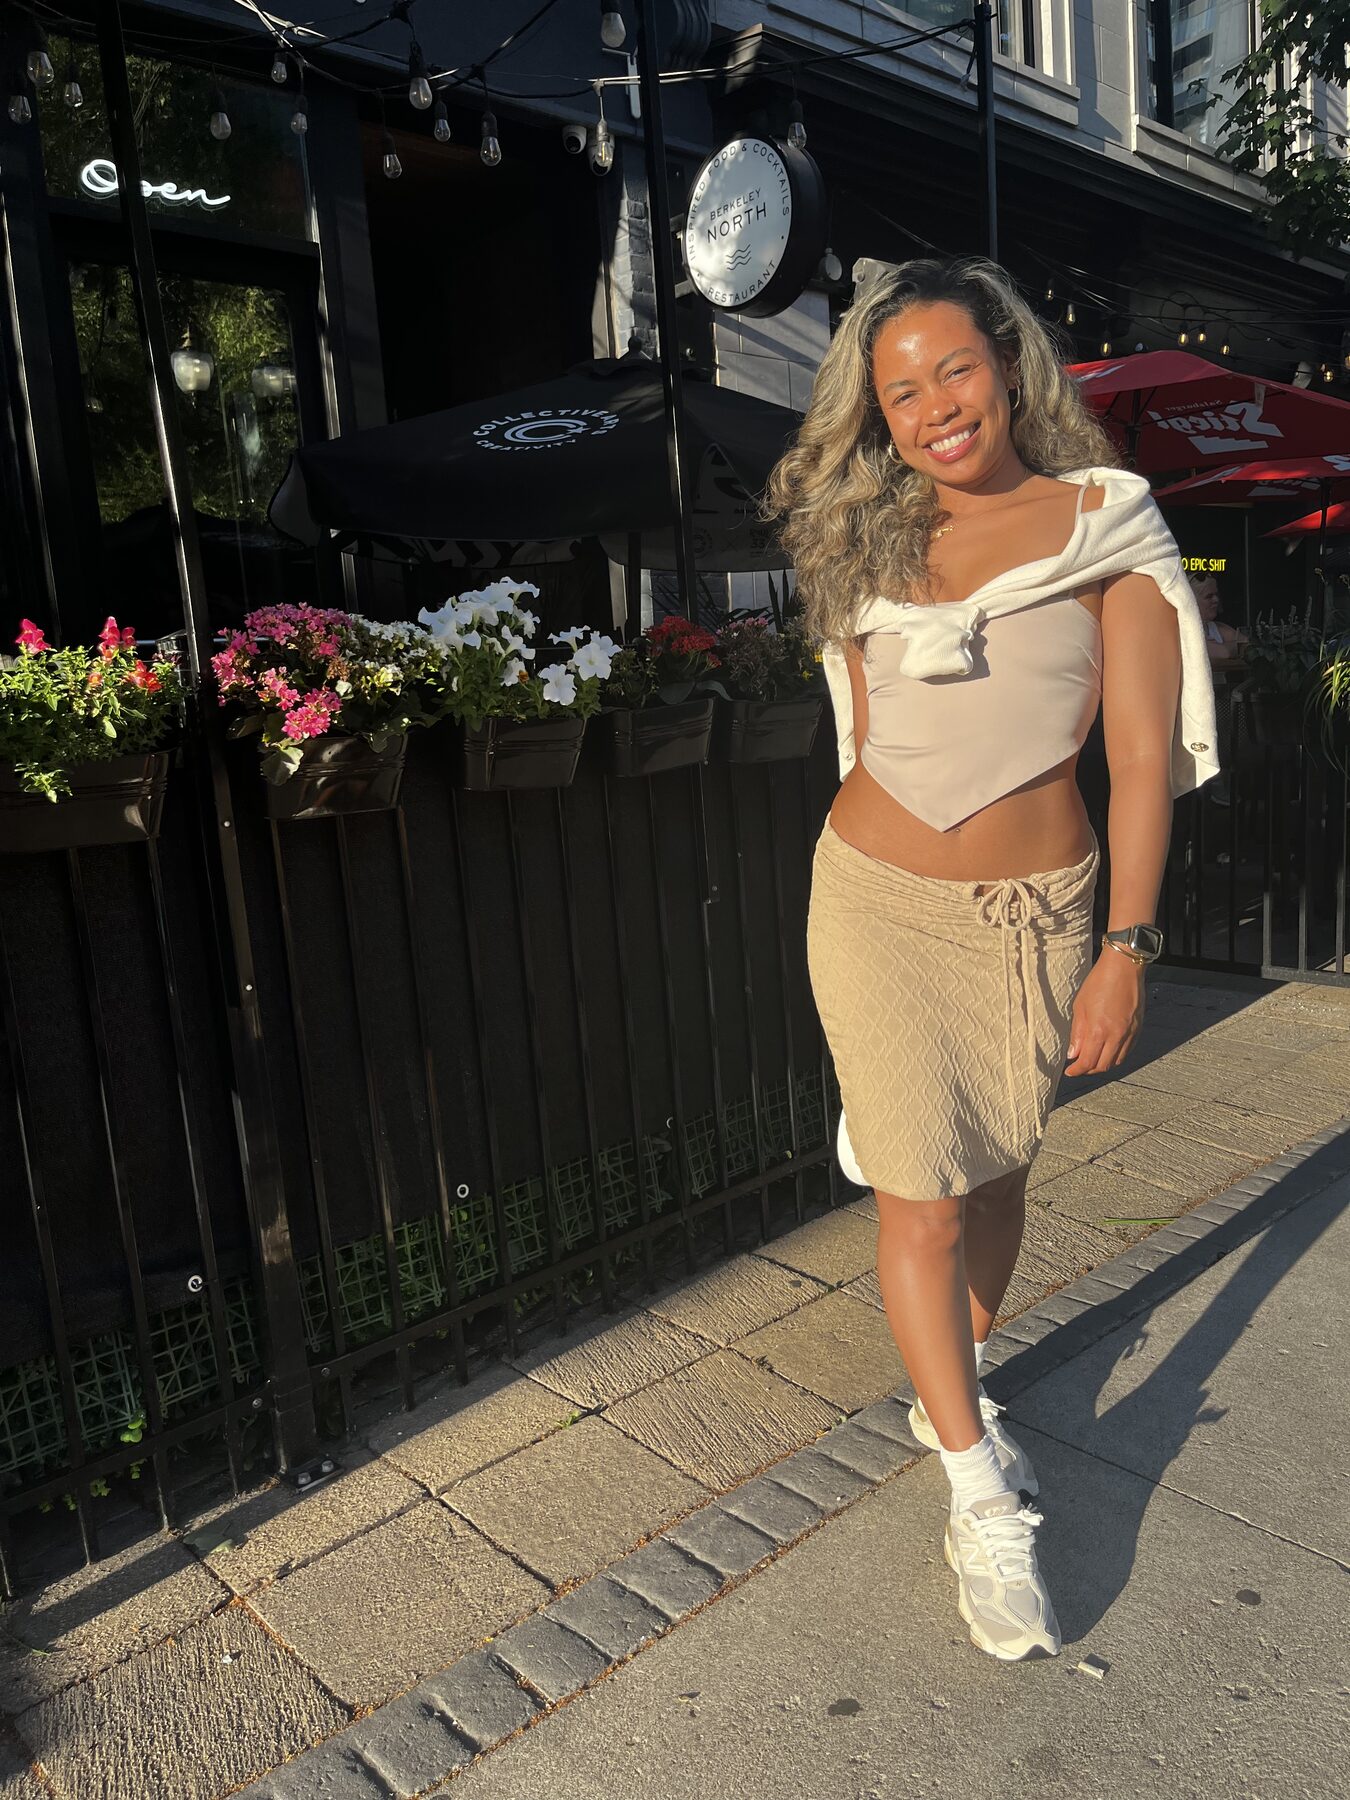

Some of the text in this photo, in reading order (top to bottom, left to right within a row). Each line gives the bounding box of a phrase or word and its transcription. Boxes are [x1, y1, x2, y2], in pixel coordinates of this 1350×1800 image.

[688, 143, 789, 261] INSPIRED FOOD & COCKTAILS
[710, 188, 761, 221] BERKELEY
[707, 202, 767, 243] NORTH
[707, 259, 775, 303] RESTAURANT
[473, 409, 609, 436] COLLECTIVE
[1190, 557, 1208, 571] EPIC
[1209, 558, 1226, 572] SHIT
